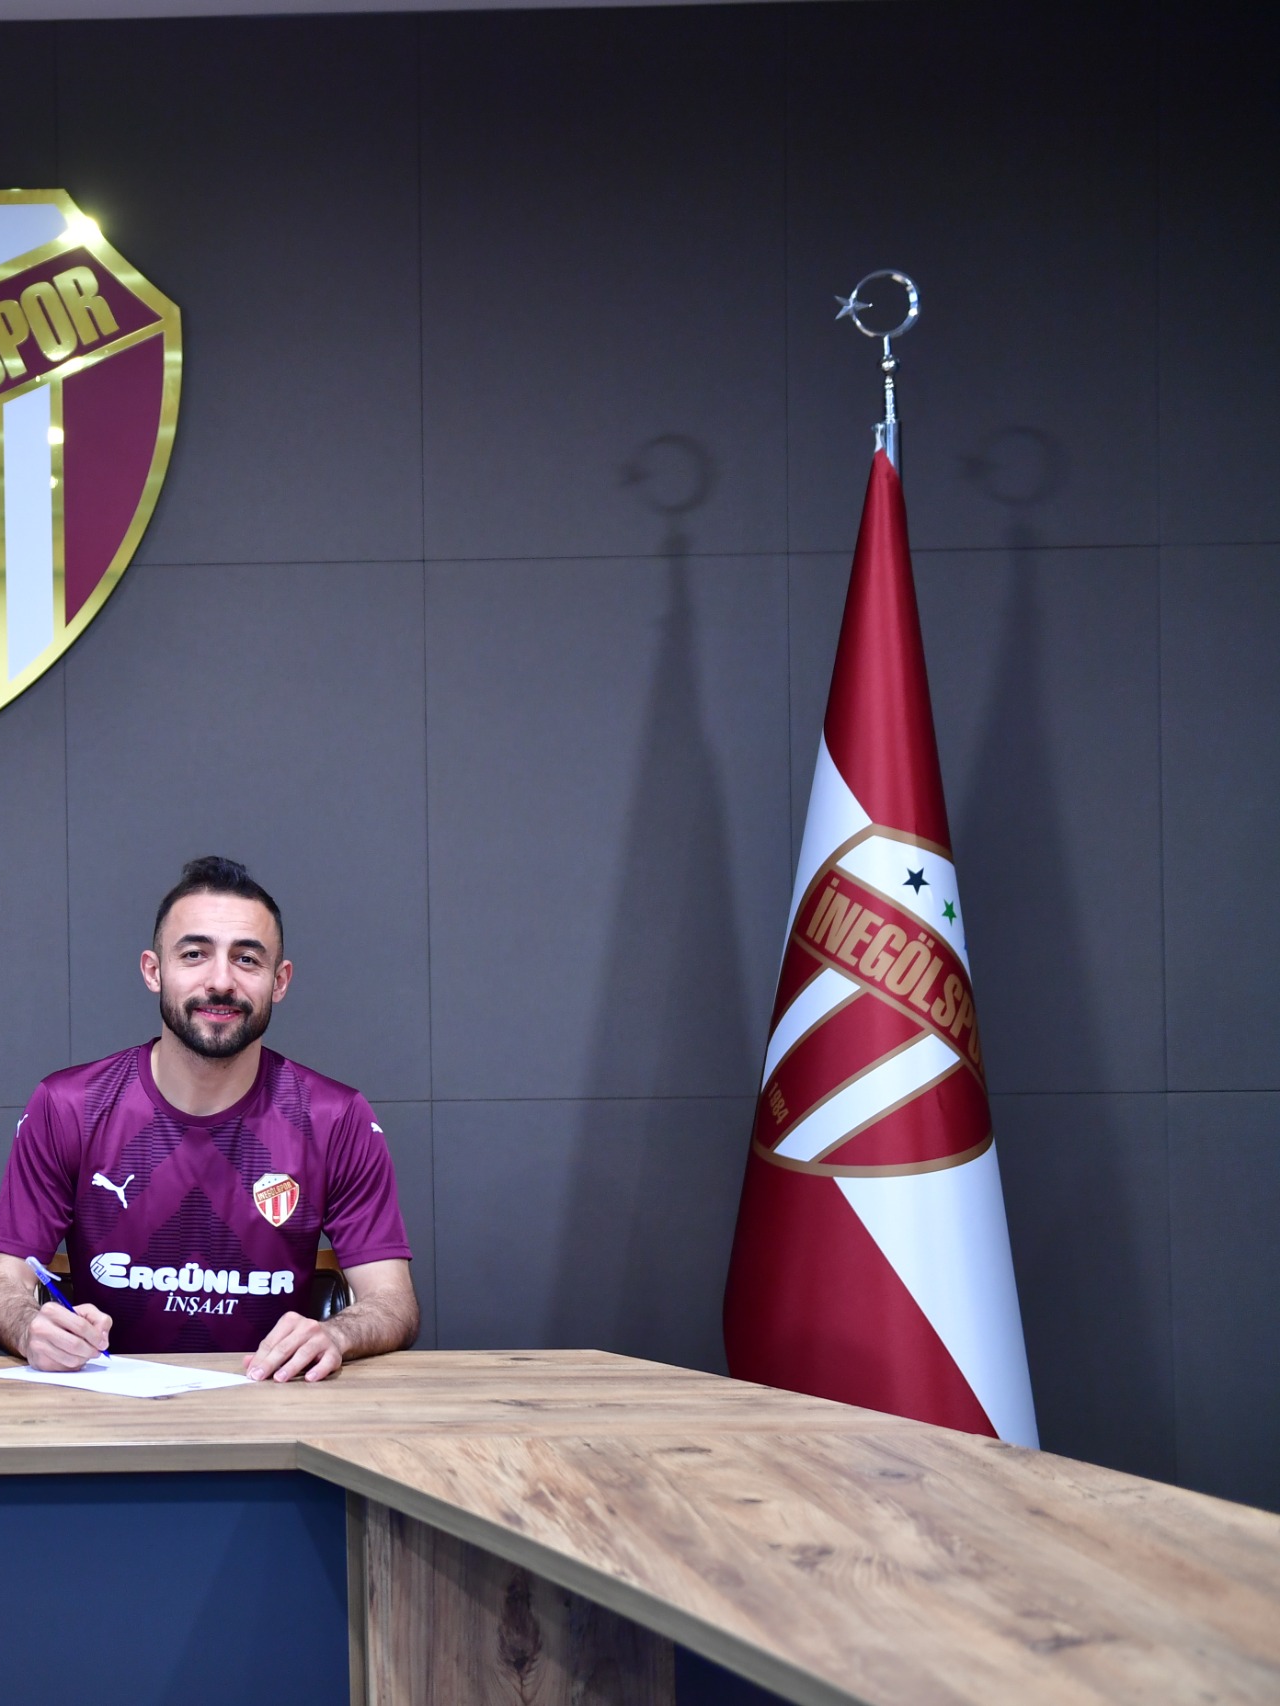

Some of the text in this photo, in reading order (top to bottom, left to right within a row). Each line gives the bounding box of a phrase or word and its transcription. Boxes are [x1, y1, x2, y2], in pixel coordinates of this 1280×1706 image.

[806, 878, 982, 1068] İNEGÖLSPO
[768, 1082, 789, 1125] 1984
[90, 1252, 294, 1295] ERGÜNLER
[163, 1292, 239, 1315] İNŞAAT
